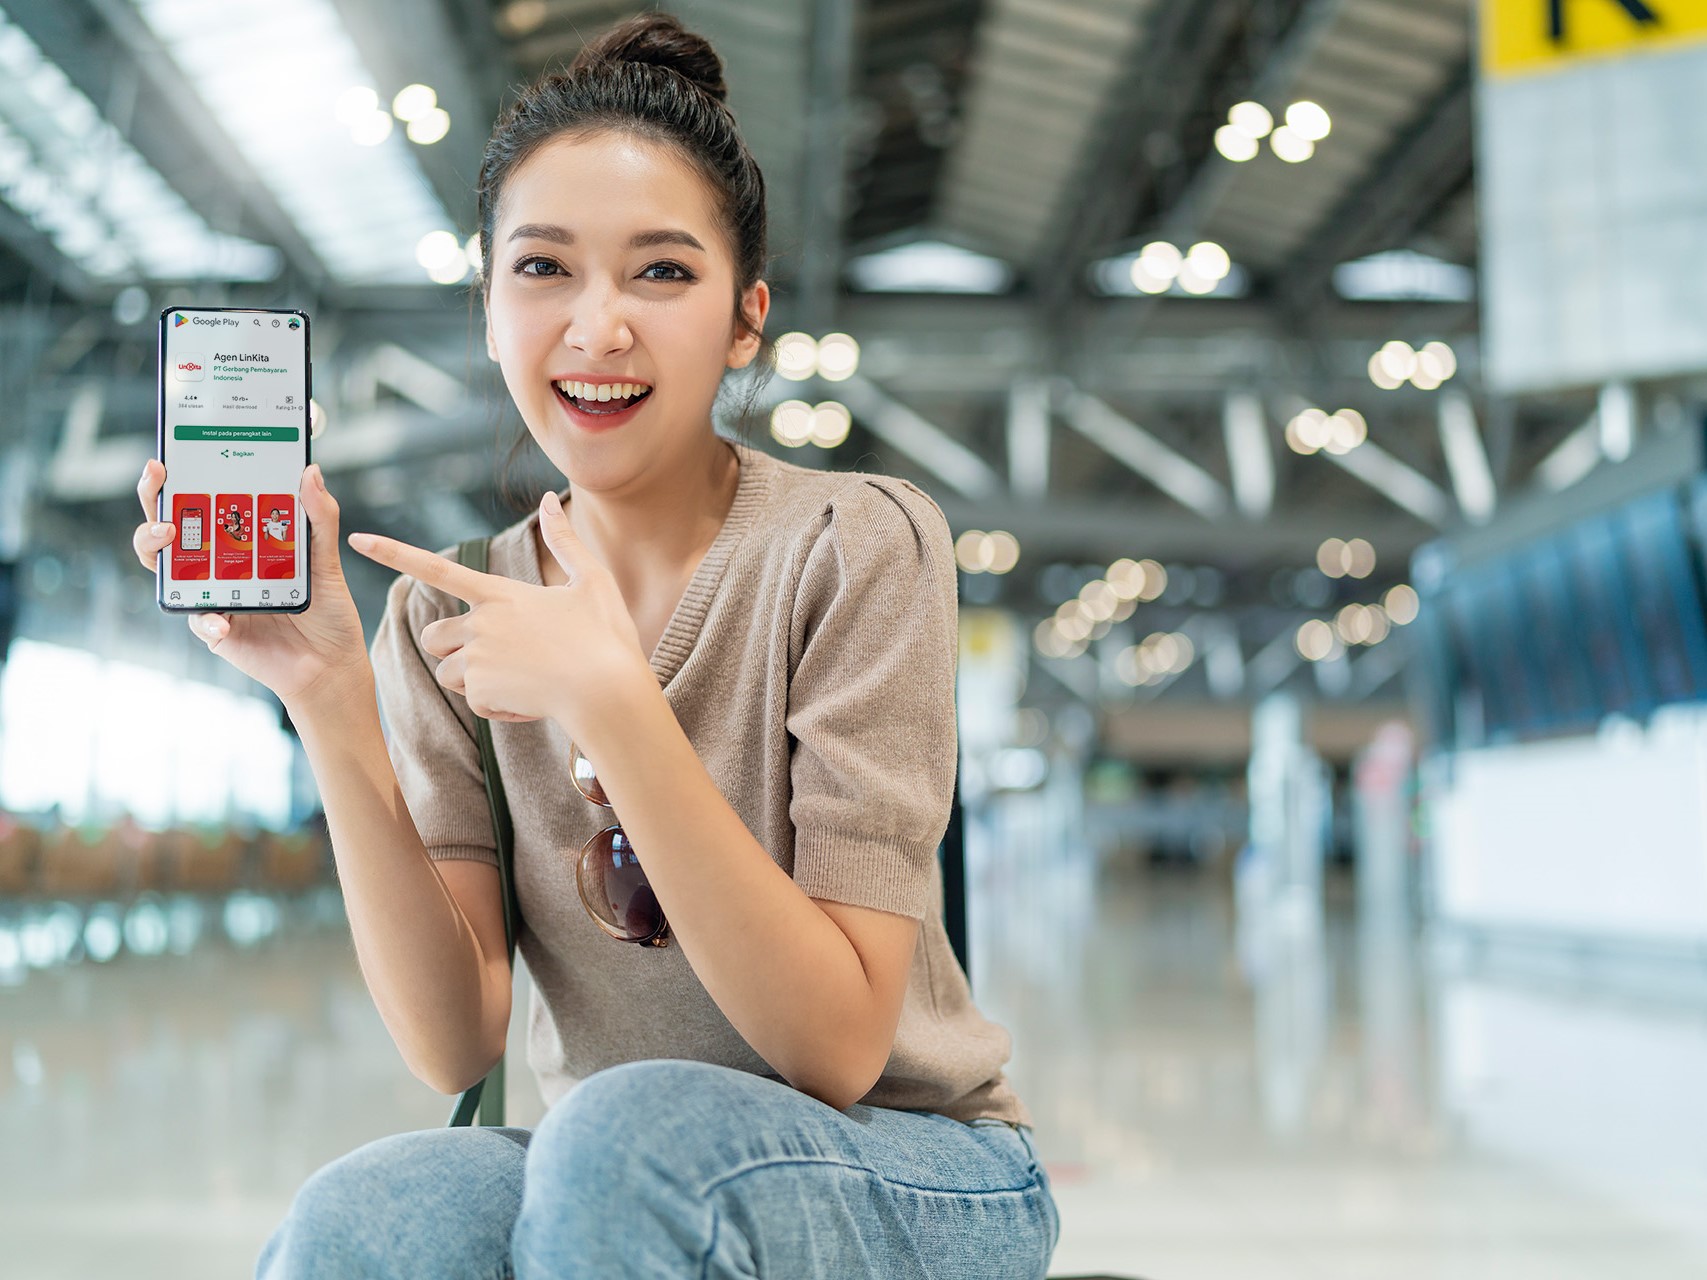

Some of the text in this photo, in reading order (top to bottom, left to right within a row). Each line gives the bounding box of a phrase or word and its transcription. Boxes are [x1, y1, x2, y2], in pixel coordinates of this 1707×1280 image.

[192, 316, 240, 328] Google Play
[213, 353, 270, 363] Agen LinKita
